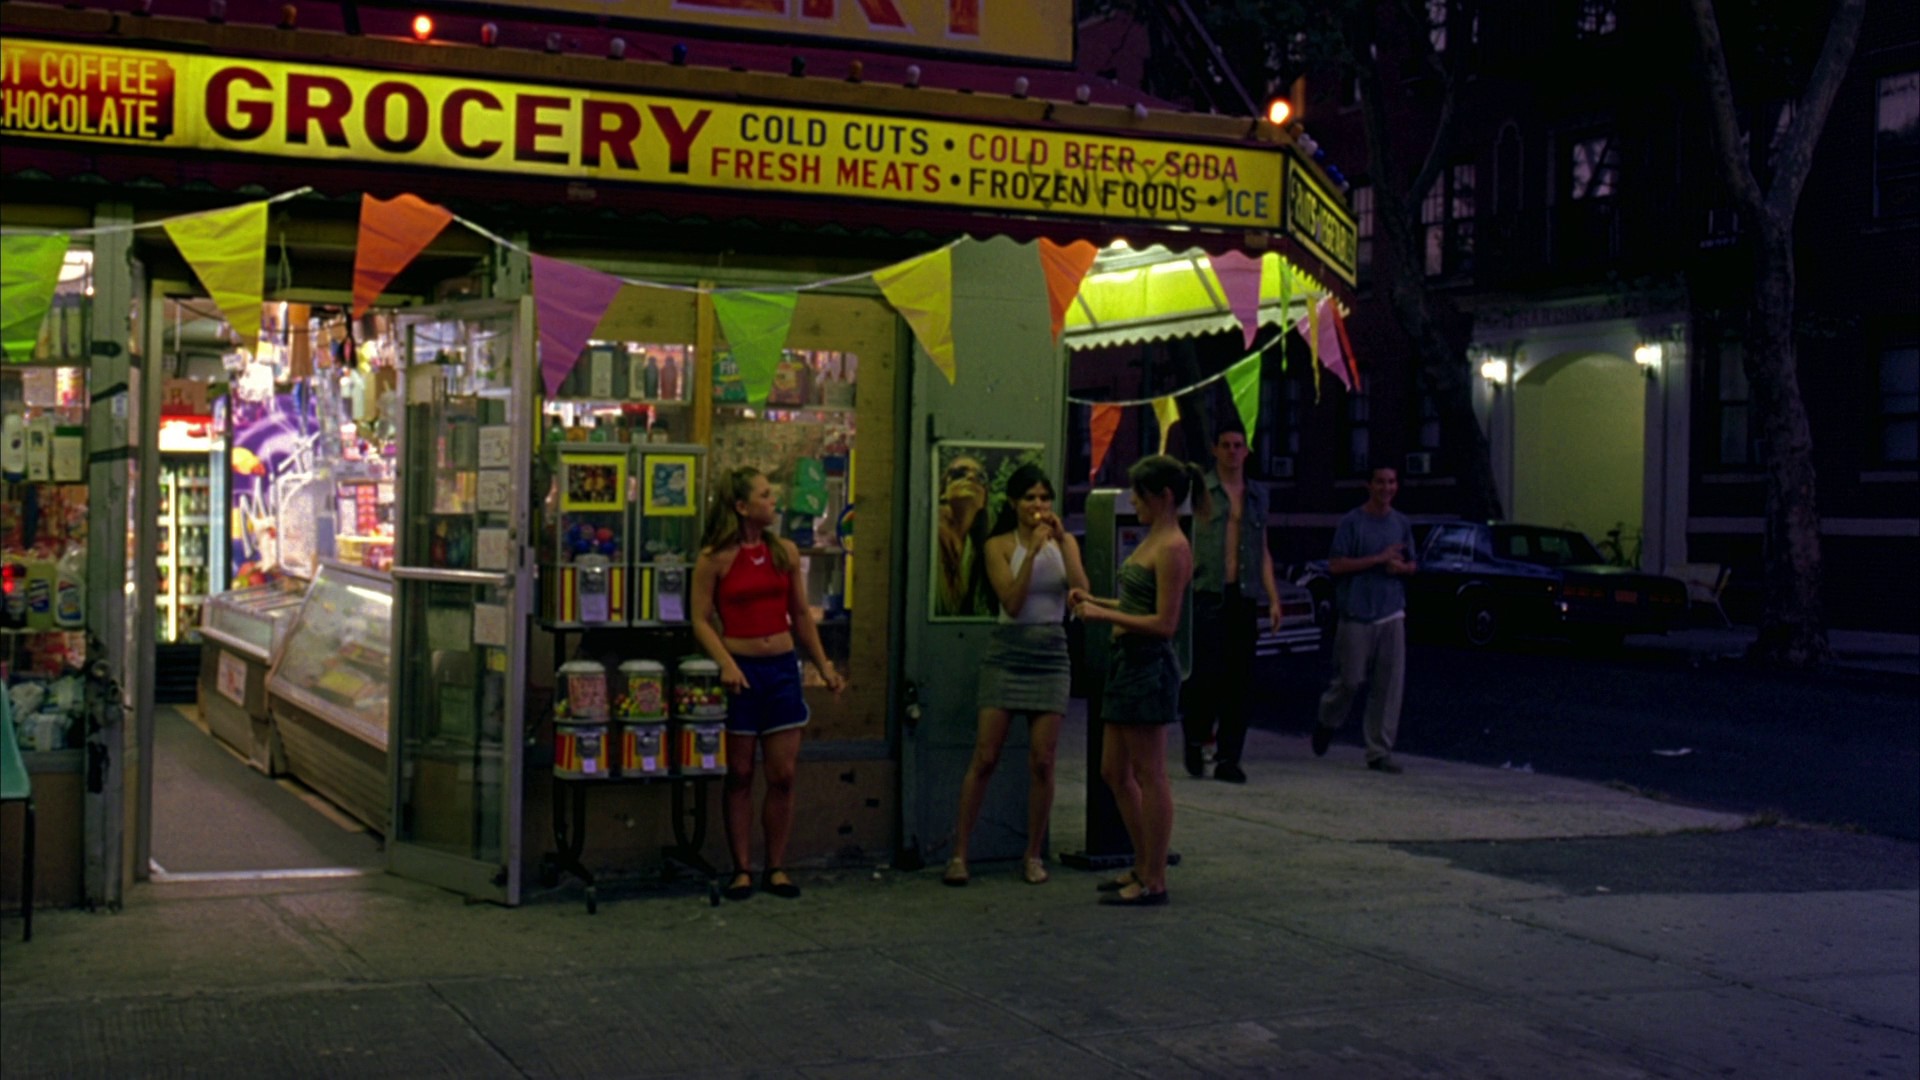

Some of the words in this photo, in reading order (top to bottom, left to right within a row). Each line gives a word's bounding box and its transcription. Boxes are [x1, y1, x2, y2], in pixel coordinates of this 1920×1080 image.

[40, 52, 158, 96] COFFEE
[0, 88, 158, 138] HOCOLATE
[205, 67, 712, 173] GROCERY
[740, 113, 828, 146] COLD
[844, 122, 930, 155] CUTS
[969, 133, 1049, 167] COLD
[1064, 141, 1138, 175] BEER
[1165, 151, 1239, 183] SODA
[711, 148, 821, 184] FRESH
[836, 158, 941, 193] MEATS
[969, 168, 1090, 205] FROZEN
[1102, 178, 1198, 214] FOODS
[1227, 190, 1269, 219] ICE
